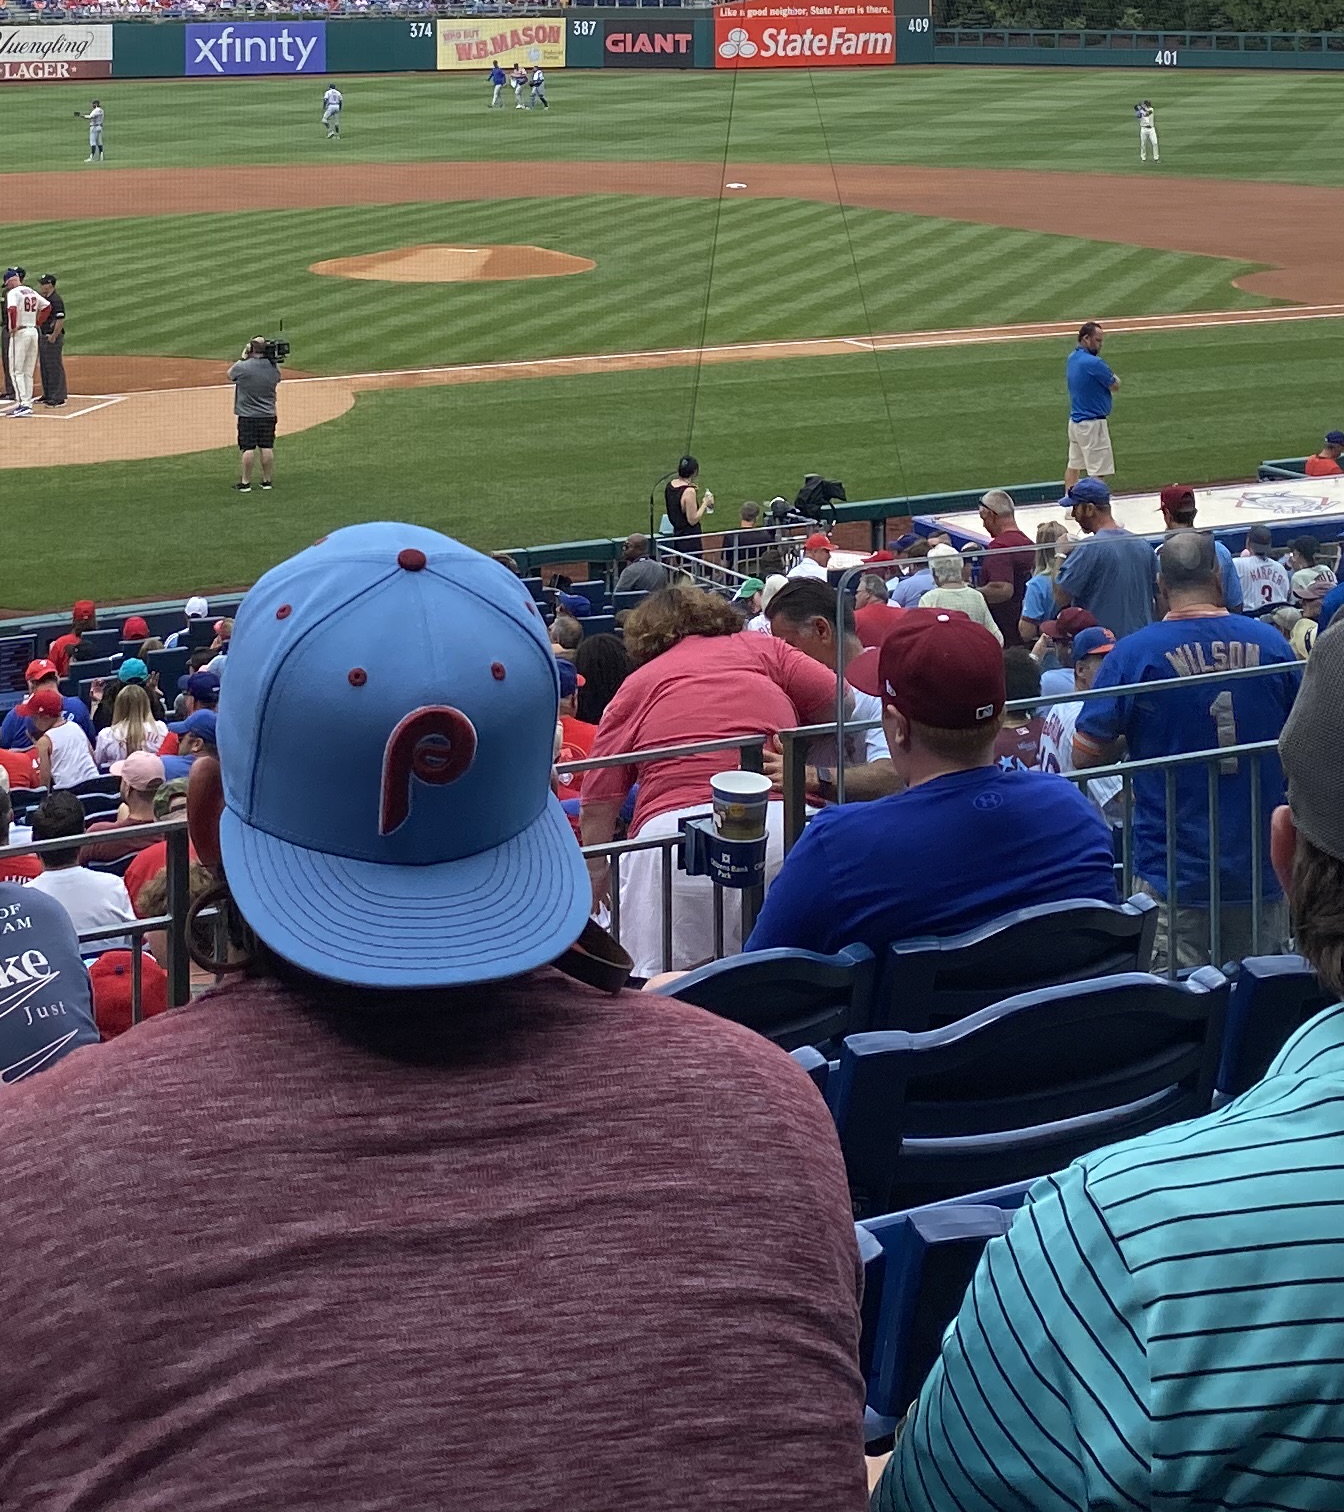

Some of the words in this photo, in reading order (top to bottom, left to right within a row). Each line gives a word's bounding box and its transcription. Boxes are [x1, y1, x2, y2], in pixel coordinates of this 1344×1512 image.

[720, 7, 737, 17] Like
[747, 7, 767, 18] good
[770, 6, 808, 18] neighbor,
[810, 6, 832, 15] State
[835, 5, 855, 15] Farm
[867, 5, 891, 14] there.
[410, 22, 433, 38] 374
[573, 21, 596, 36] 387
[908, 18, 929, 33] 409
[194, 27, 317, 73] xfinity
[606, 33, 692, 54] GIANT
[1156, 51, 1178, 66] 401
[4, 62, 70, 79] LAGER
[1165, 640, 1260, 677] WILSON
[1210, 690, 1237, 775] 1
[24, 999, 68, 1027] Just
